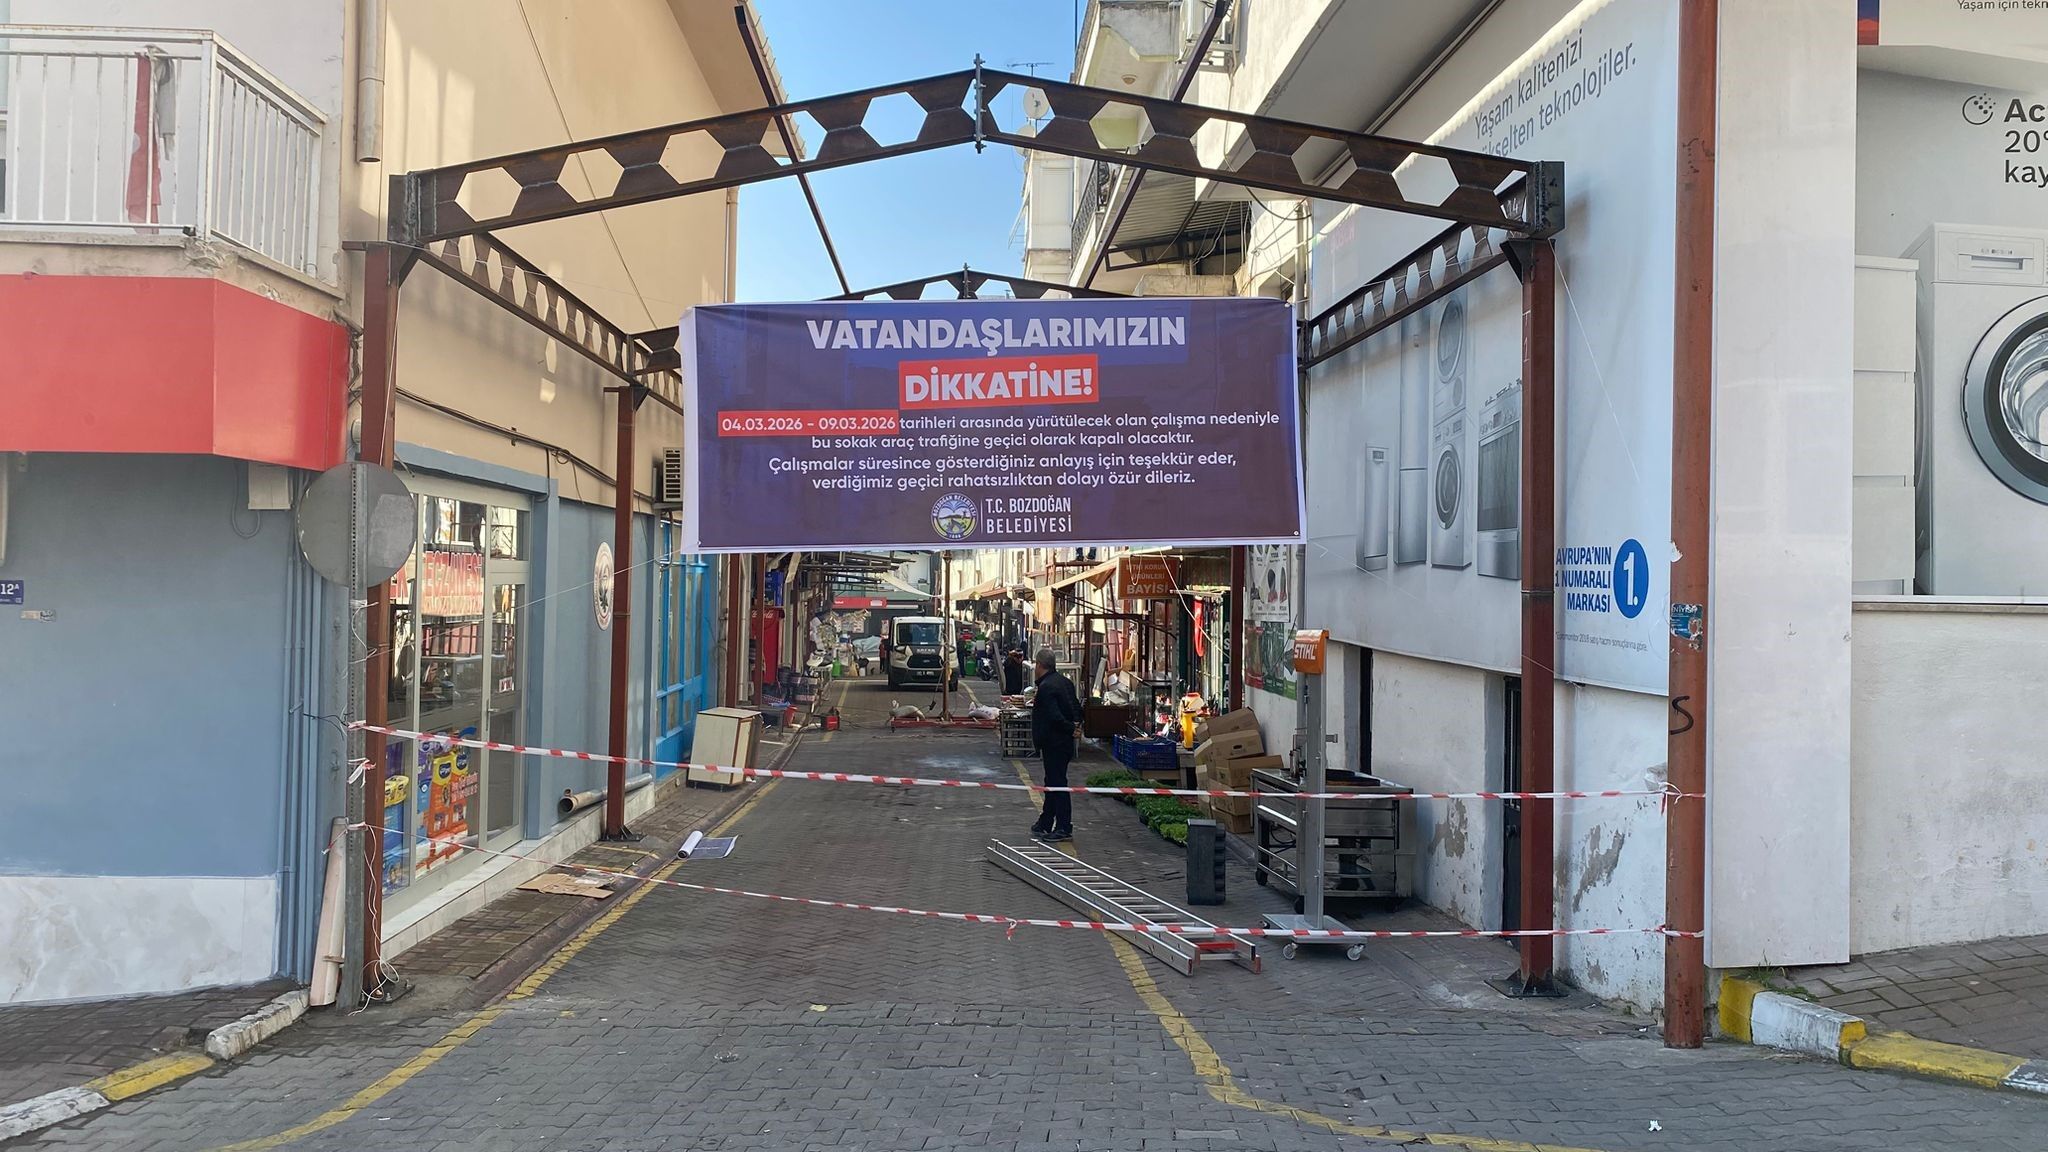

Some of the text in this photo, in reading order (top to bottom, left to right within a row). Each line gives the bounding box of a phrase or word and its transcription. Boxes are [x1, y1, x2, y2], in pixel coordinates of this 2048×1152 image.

[1957, 0, 1995, 11] Yaşam
[1998, 0, 2019, 11] için
[1474, 29, 1583, 139] Yaşam kalitenizi
[1539, 42, 1637, 130] teknolojiler.
[2003, 98, 2046, 123] Ac
[806, 316, 1186, 356] VATANDAŞLARIMIZIN
[904, 362, 1093, 402] DİKKATİNE!
[721, 417, 803, 432] 04.03.2026
[818, 416, 896, 431] 09.03.2026
[899, 415, 956, 429] tarihleri
[959, 414, 1024, 429] arasında
[1027, 413, 1112, 430] yürütülecek
[1115, 412, 1147, 427] olan
[1150, 412, 1206, 428] çalışma
[1210, 410, 1280, 427] nedeniyle
[811, 431, 1194, 453] bu sokak araç trafiğine geçici olarak kapalı olacaktır.
[768, 452, 1237, 474] Çalışmalar süresince gösterdiğiniz anlayış için teşekkür eder,
[812, 470, 1196, 492] verdiğimiz geçici rahatsızlıktan dolayı özür dileriz.
[985, 495, 1071, 514] T.C. BOZDOĞAN
[986, 515, 1072, 534] BELEDİYESİ
[1555, 546, 1611, 565] AVRUPA'NIN
[1561, 570, 1611, 589] NUMARALI
[1567, 594, 1611, 613] MARKASI
[1294, 643, 1316, 660] STIHL
